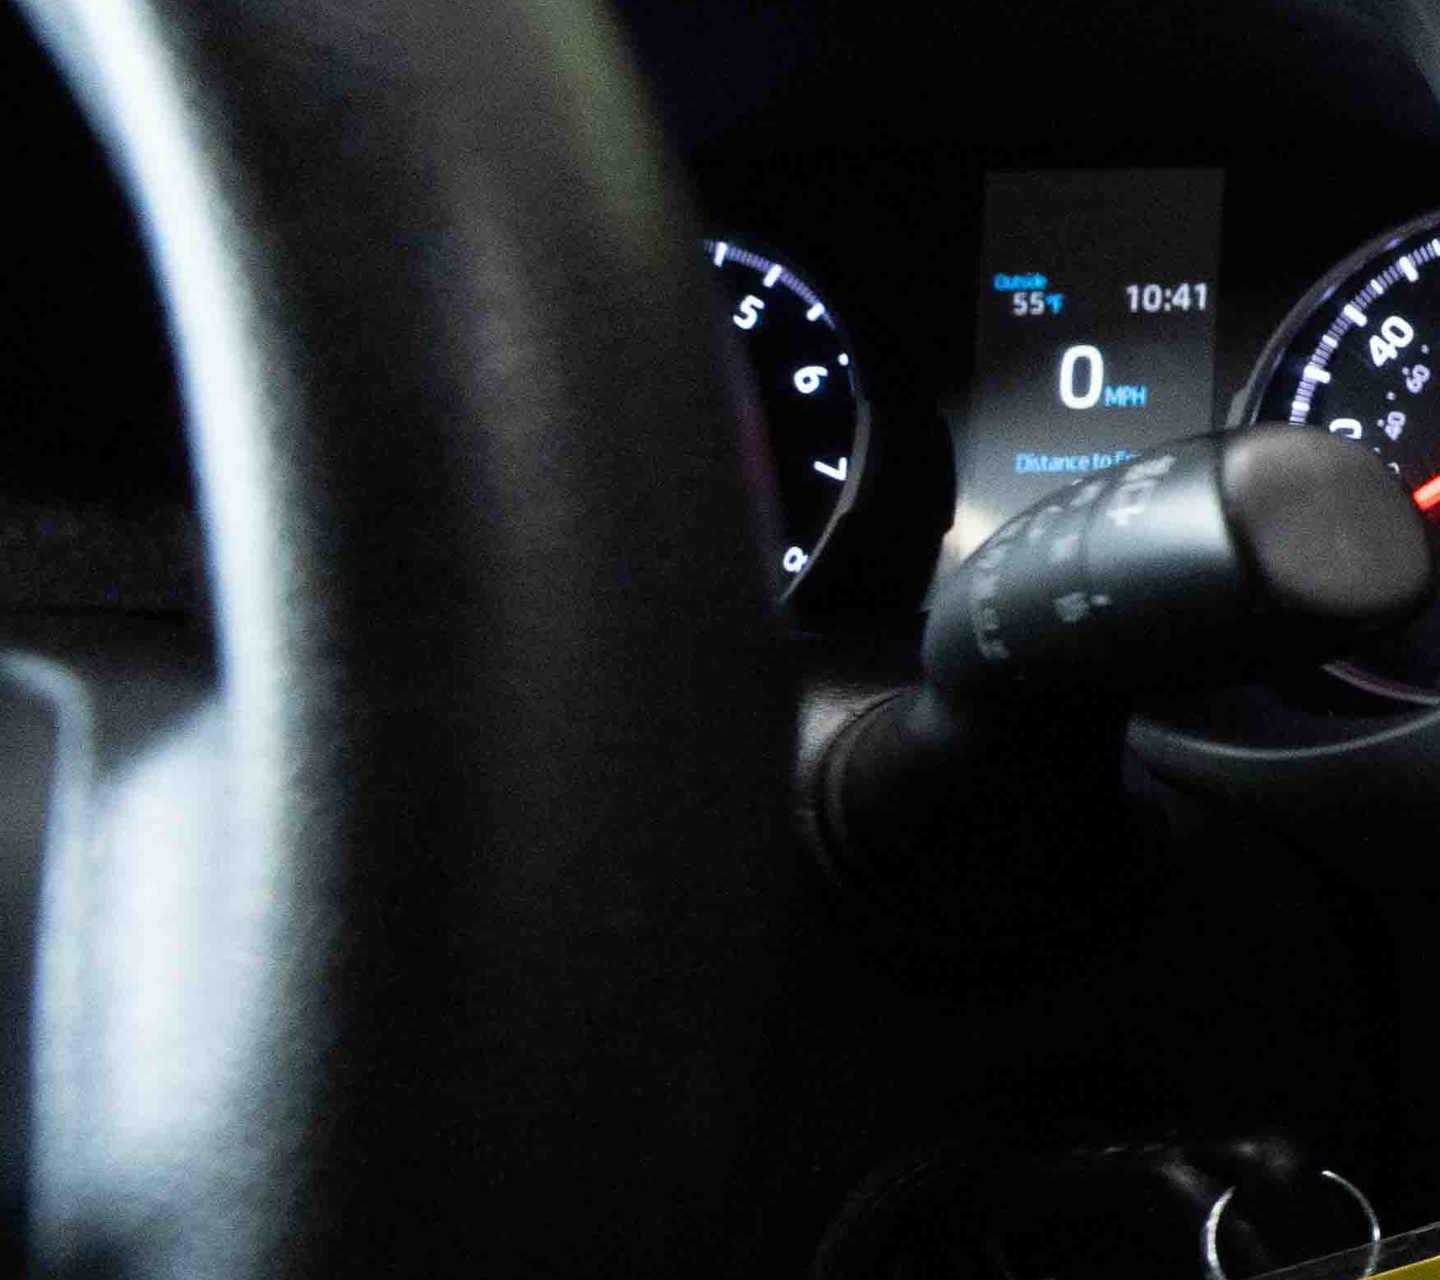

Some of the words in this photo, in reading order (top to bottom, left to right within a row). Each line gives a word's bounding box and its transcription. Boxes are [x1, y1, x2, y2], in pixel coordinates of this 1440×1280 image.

[733, 294, 765, 330] 5
[1126, 282, 1208, 313] 10:41
[1369, 315, 1414, 367] 40
[793, 364, 829, 394] 6
[1059, 344, 1104, 410] 0
[1104, 385, 1148, 407] MPH
[814, 456, 848, 481] 7
[1014, 453, 1090, 473] Distance
[1093, 452, 1111, 469] to
